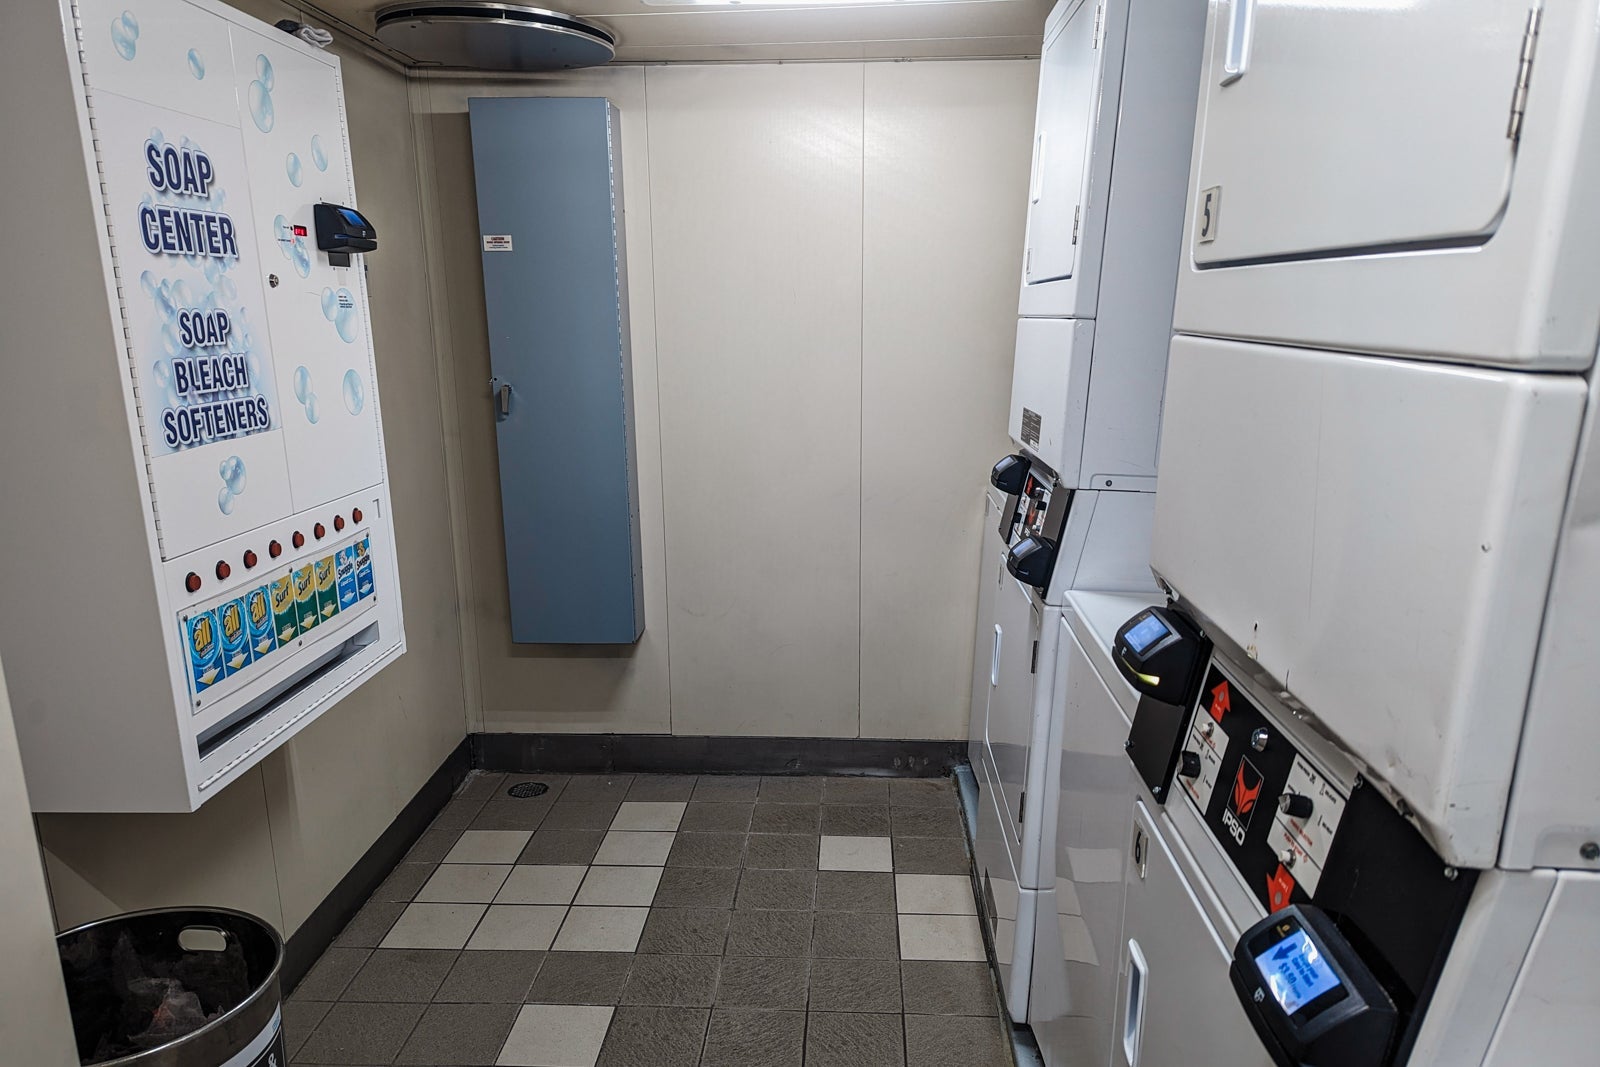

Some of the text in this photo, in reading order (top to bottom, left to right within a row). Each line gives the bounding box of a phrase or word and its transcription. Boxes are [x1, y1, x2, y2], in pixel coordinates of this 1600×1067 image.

[145, 139, 213, 197] SOAP
[139, 203, 238, 258] CENTER
[1201, 192, 1212, 237] 5
[178, 308, 230, 348] SOAP
[173, 355, 249, 396] BLEACH
[162, 396, 270, 446] SOFTENERS
[298, 571, 311, 596] Surf
[318, 560, 331, 586] Surf
[251, 593, 266, 623] all
[275, 581, 289, 608] Surf
[194, 617, 212, 651] all
[224, 605, 240, 636] all
[1222, 807, 1246, 847] IPSO
[1135, 831, 1142, 864] 6
